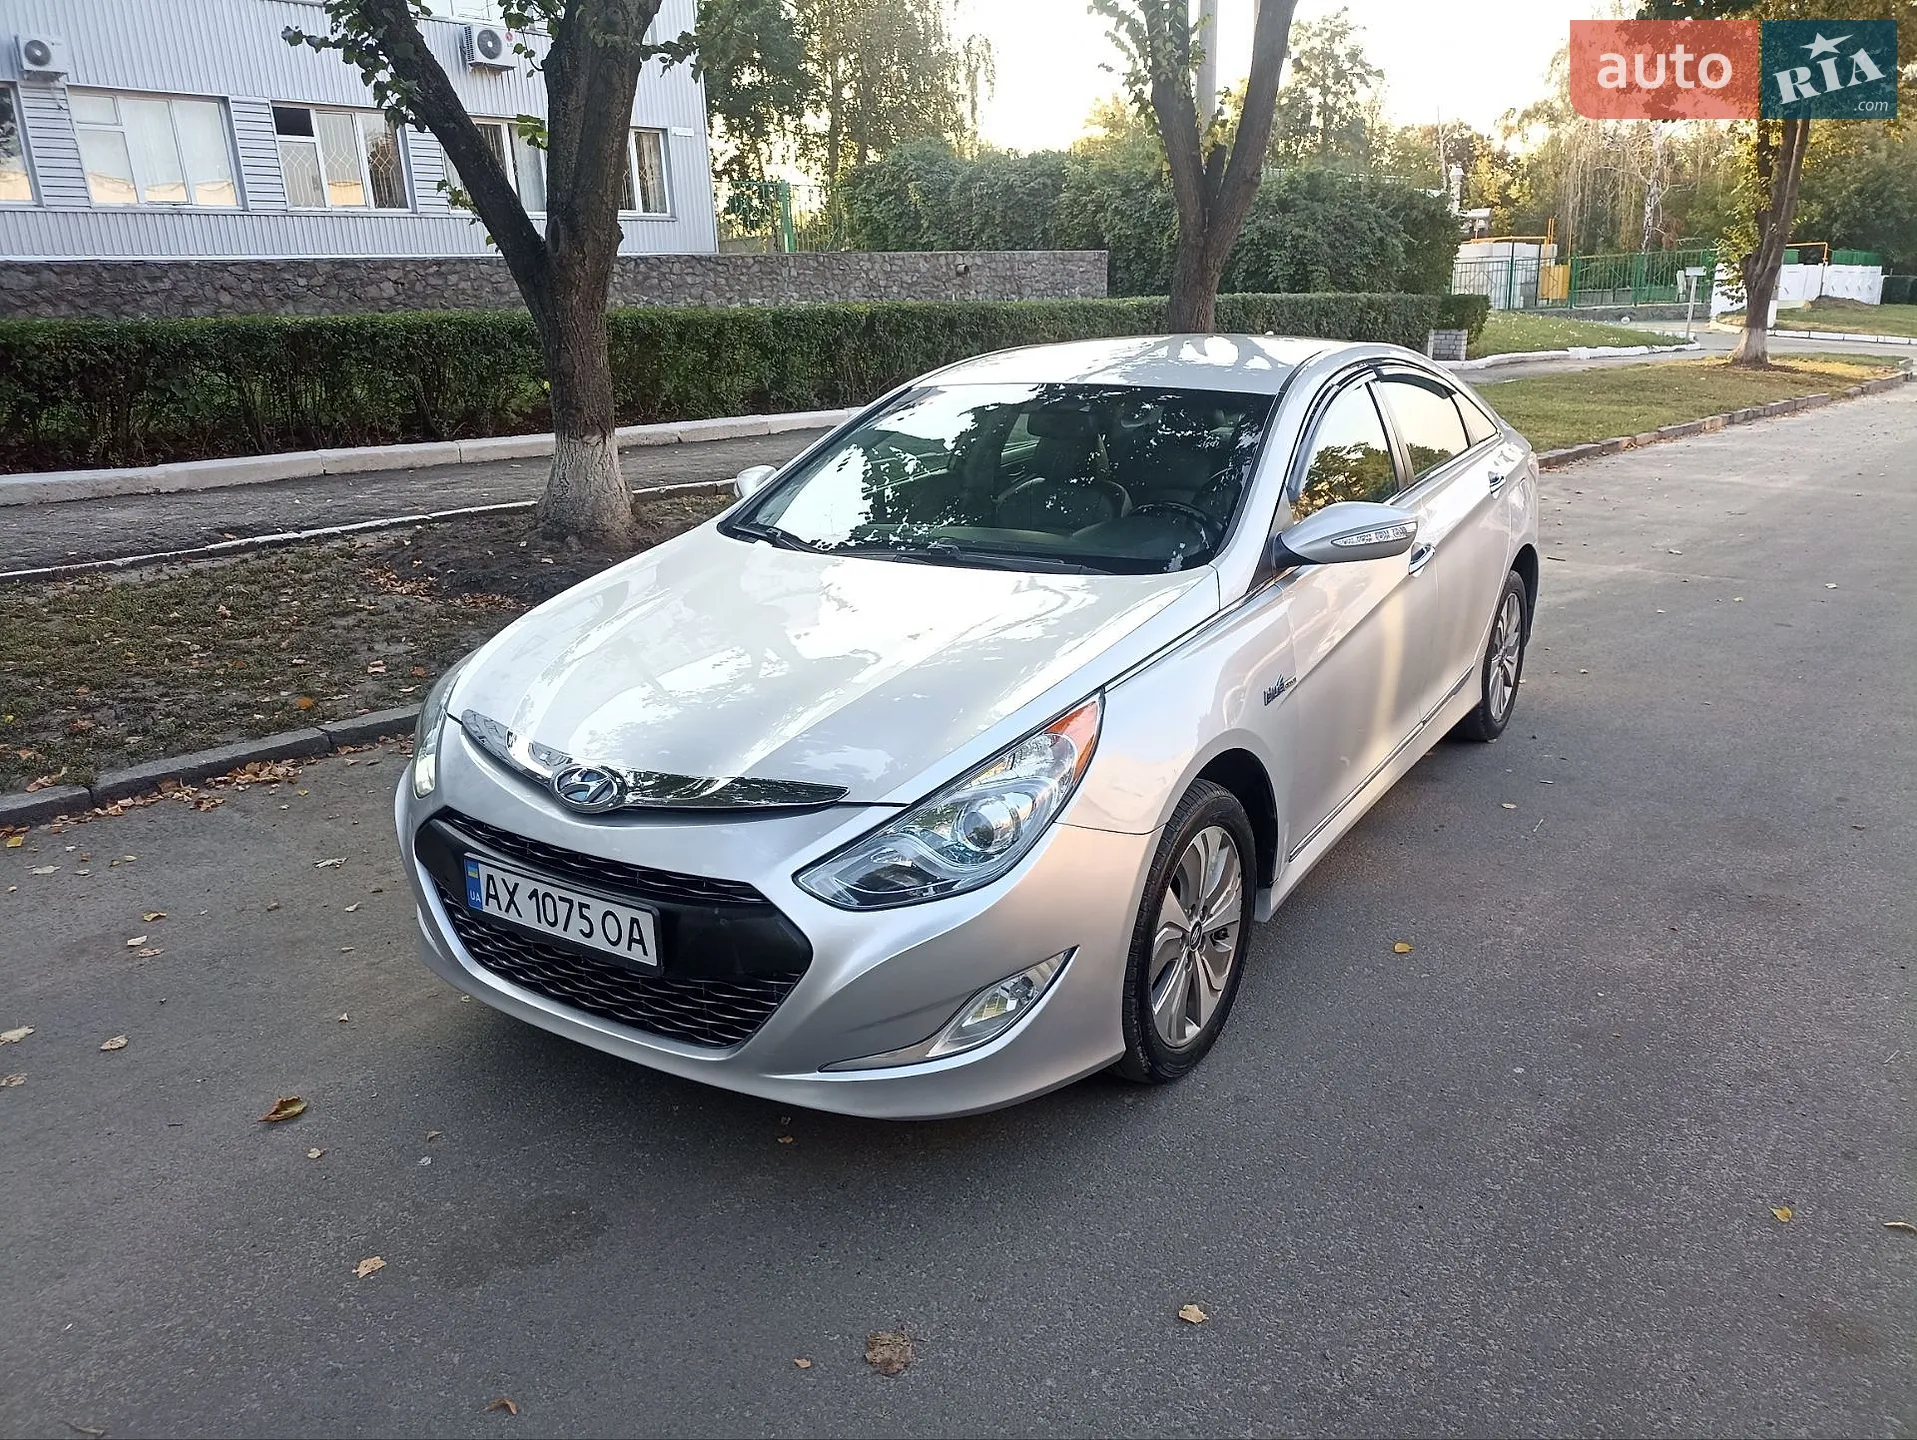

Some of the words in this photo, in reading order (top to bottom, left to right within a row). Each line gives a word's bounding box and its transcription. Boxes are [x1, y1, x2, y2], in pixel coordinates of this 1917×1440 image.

[470, 889, 481, 903] UA
[485, 874, 522, 918] AX
[528, 888, 594, 939] 1075
[601, 910, 648, 957] OA
